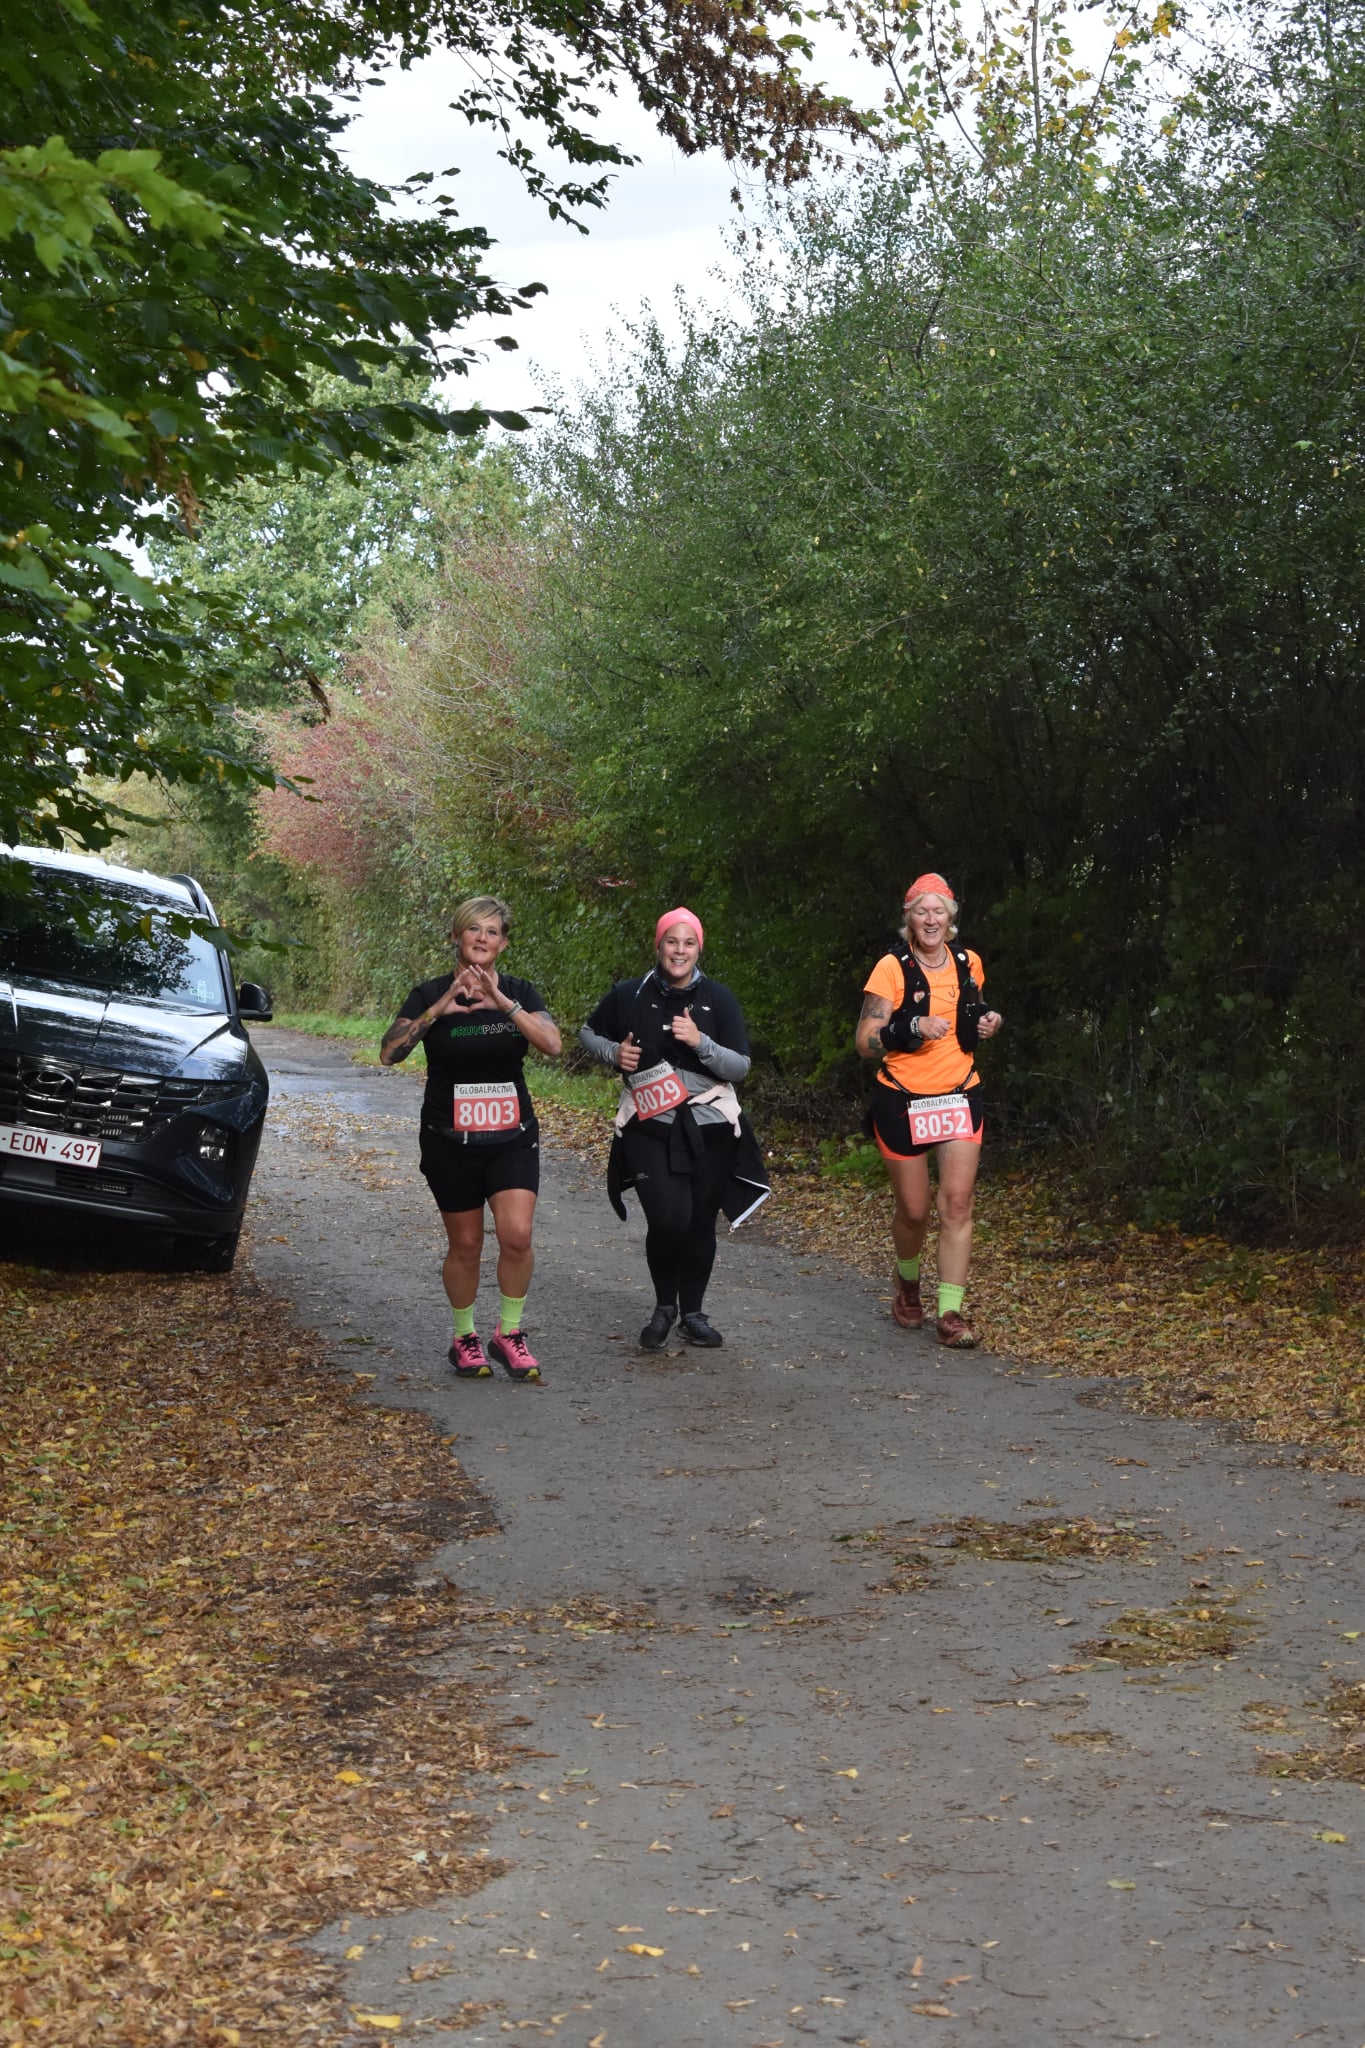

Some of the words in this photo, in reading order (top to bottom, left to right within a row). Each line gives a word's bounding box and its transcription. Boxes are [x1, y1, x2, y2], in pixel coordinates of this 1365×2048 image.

[450, 1022, 520, 1037] #RUNPAPO
[459, 1084, 513, 1095] GLOBALPACING
[635, 1080, 681, 1114] 8029
[459, 1100, 515, 1127] 8003
[913, 1096, 964, 1110] GLOBALPACING
[914, 1110, 969, 1139] 8052
